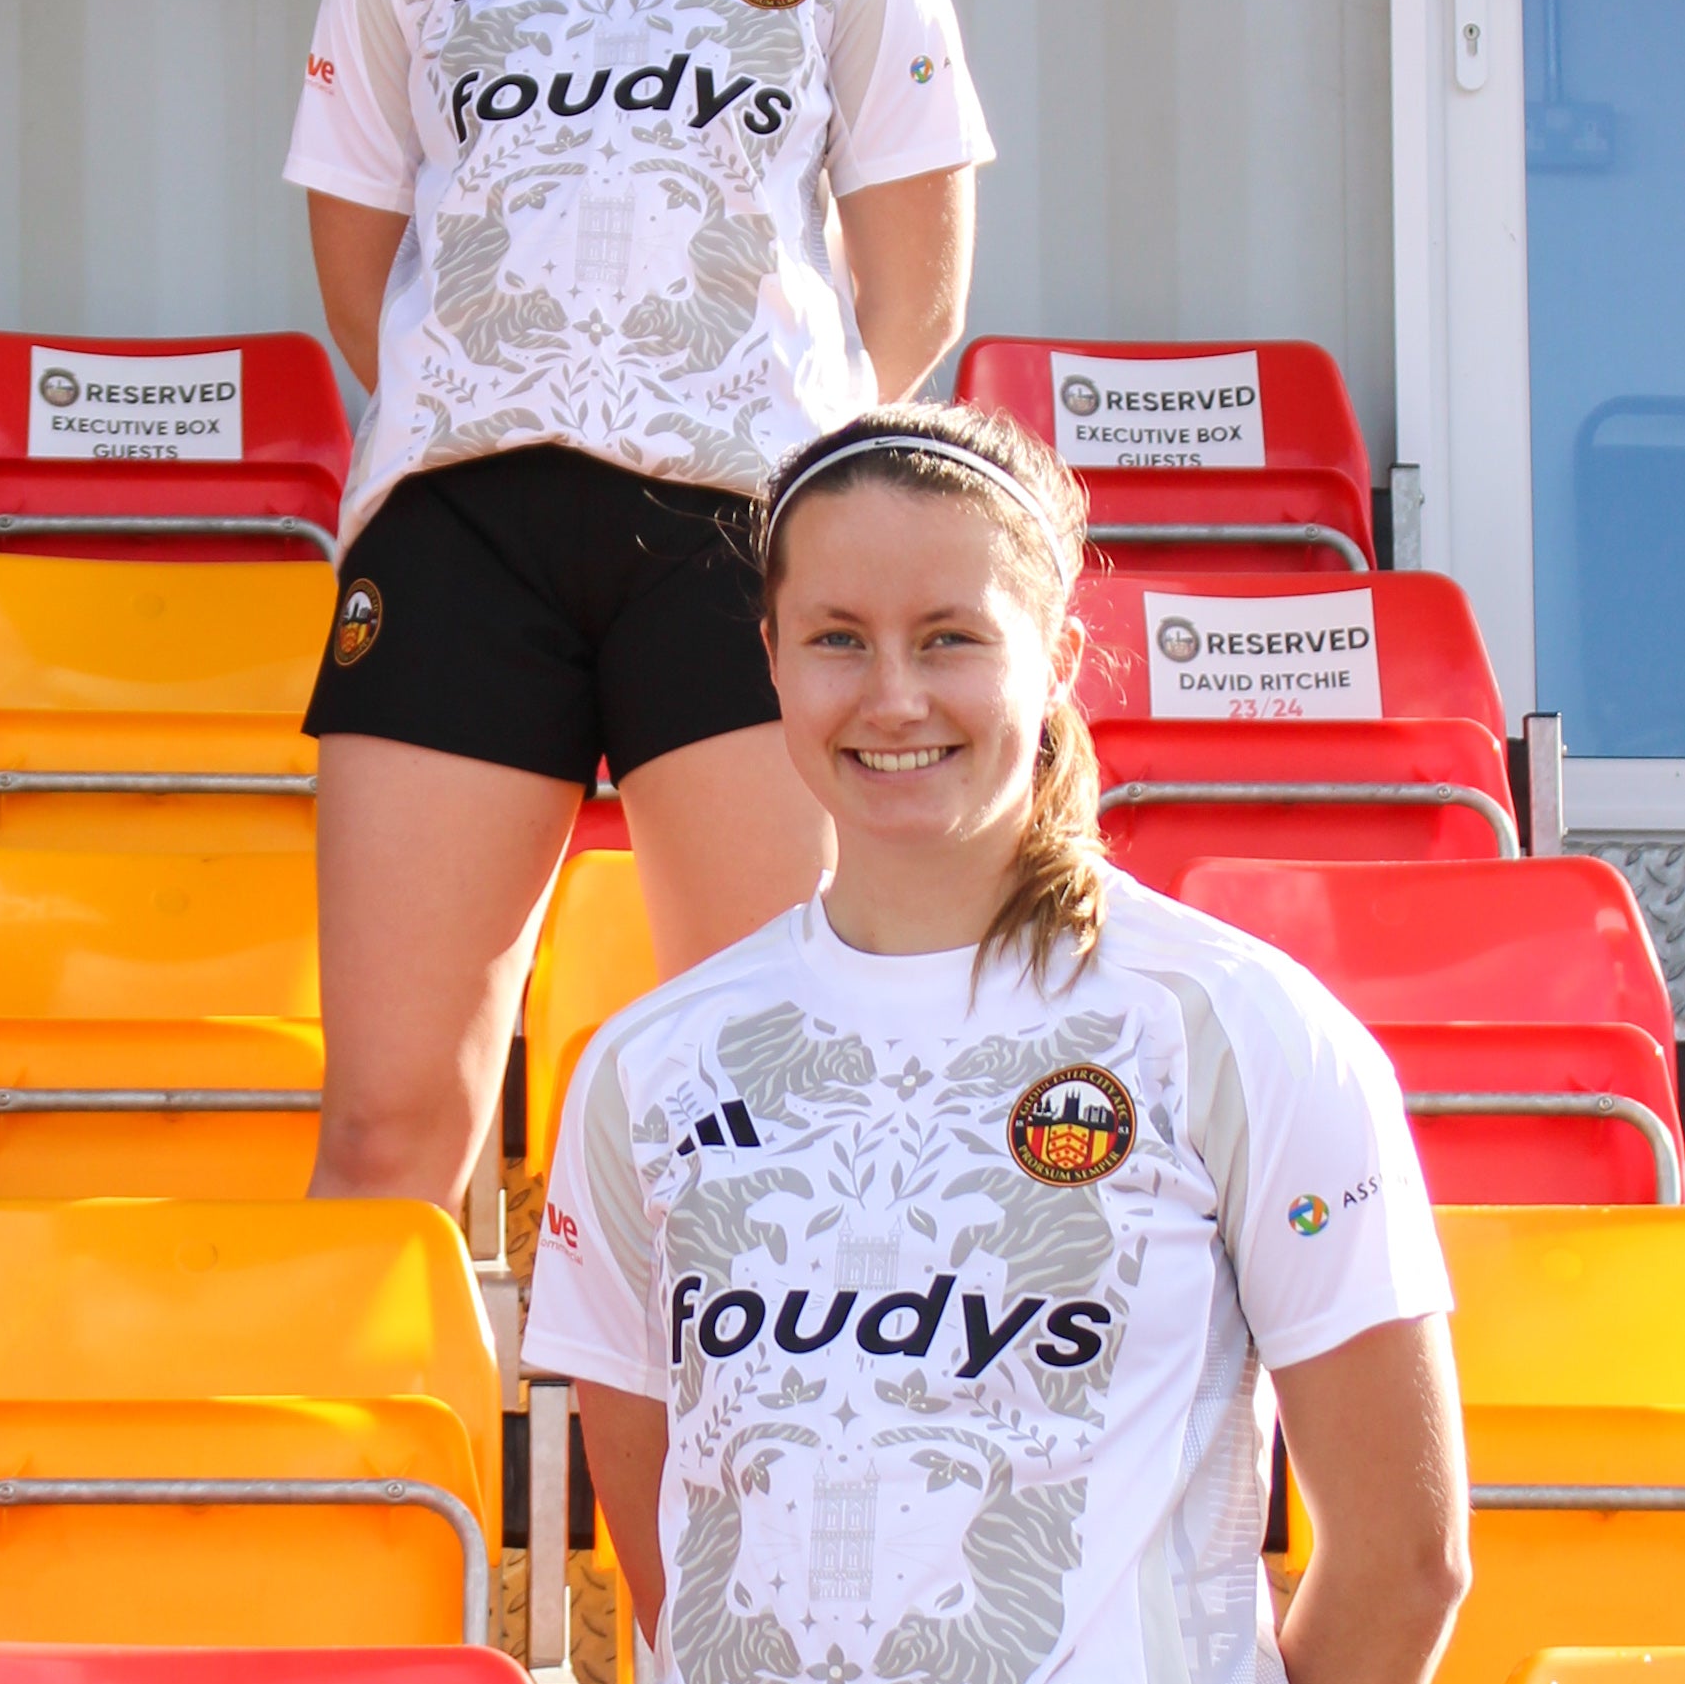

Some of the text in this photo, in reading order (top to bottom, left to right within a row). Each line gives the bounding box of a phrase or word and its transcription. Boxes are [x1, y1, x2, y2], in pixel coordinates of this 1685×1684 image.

[307, 52, 335, 85] ve
[452, 54, 791, 143] foudys
[85, 381, 237, 405] RESERVED
[1106, 385, 1256, 412] RESERVED
[51, 415, 220, 436] EXECUTIVE BOX
[1075, 424, 1243, 444] EXECUTIVE BOX
[93, 443, 179, 460] GUESTS
[1117, 452, 1202, 466] GUESTS
[1207, 626, 1371, 655] RESERVED
[1179, 670, 1351, 691] DAVID RITCHIE
[1228, 697, 1304, 719] 23/24
[1088, 1071, 1115, 1095] CITY
[546, 1201, 578, 1249] ve
[671, 1275, 1112, 1379] foudys
